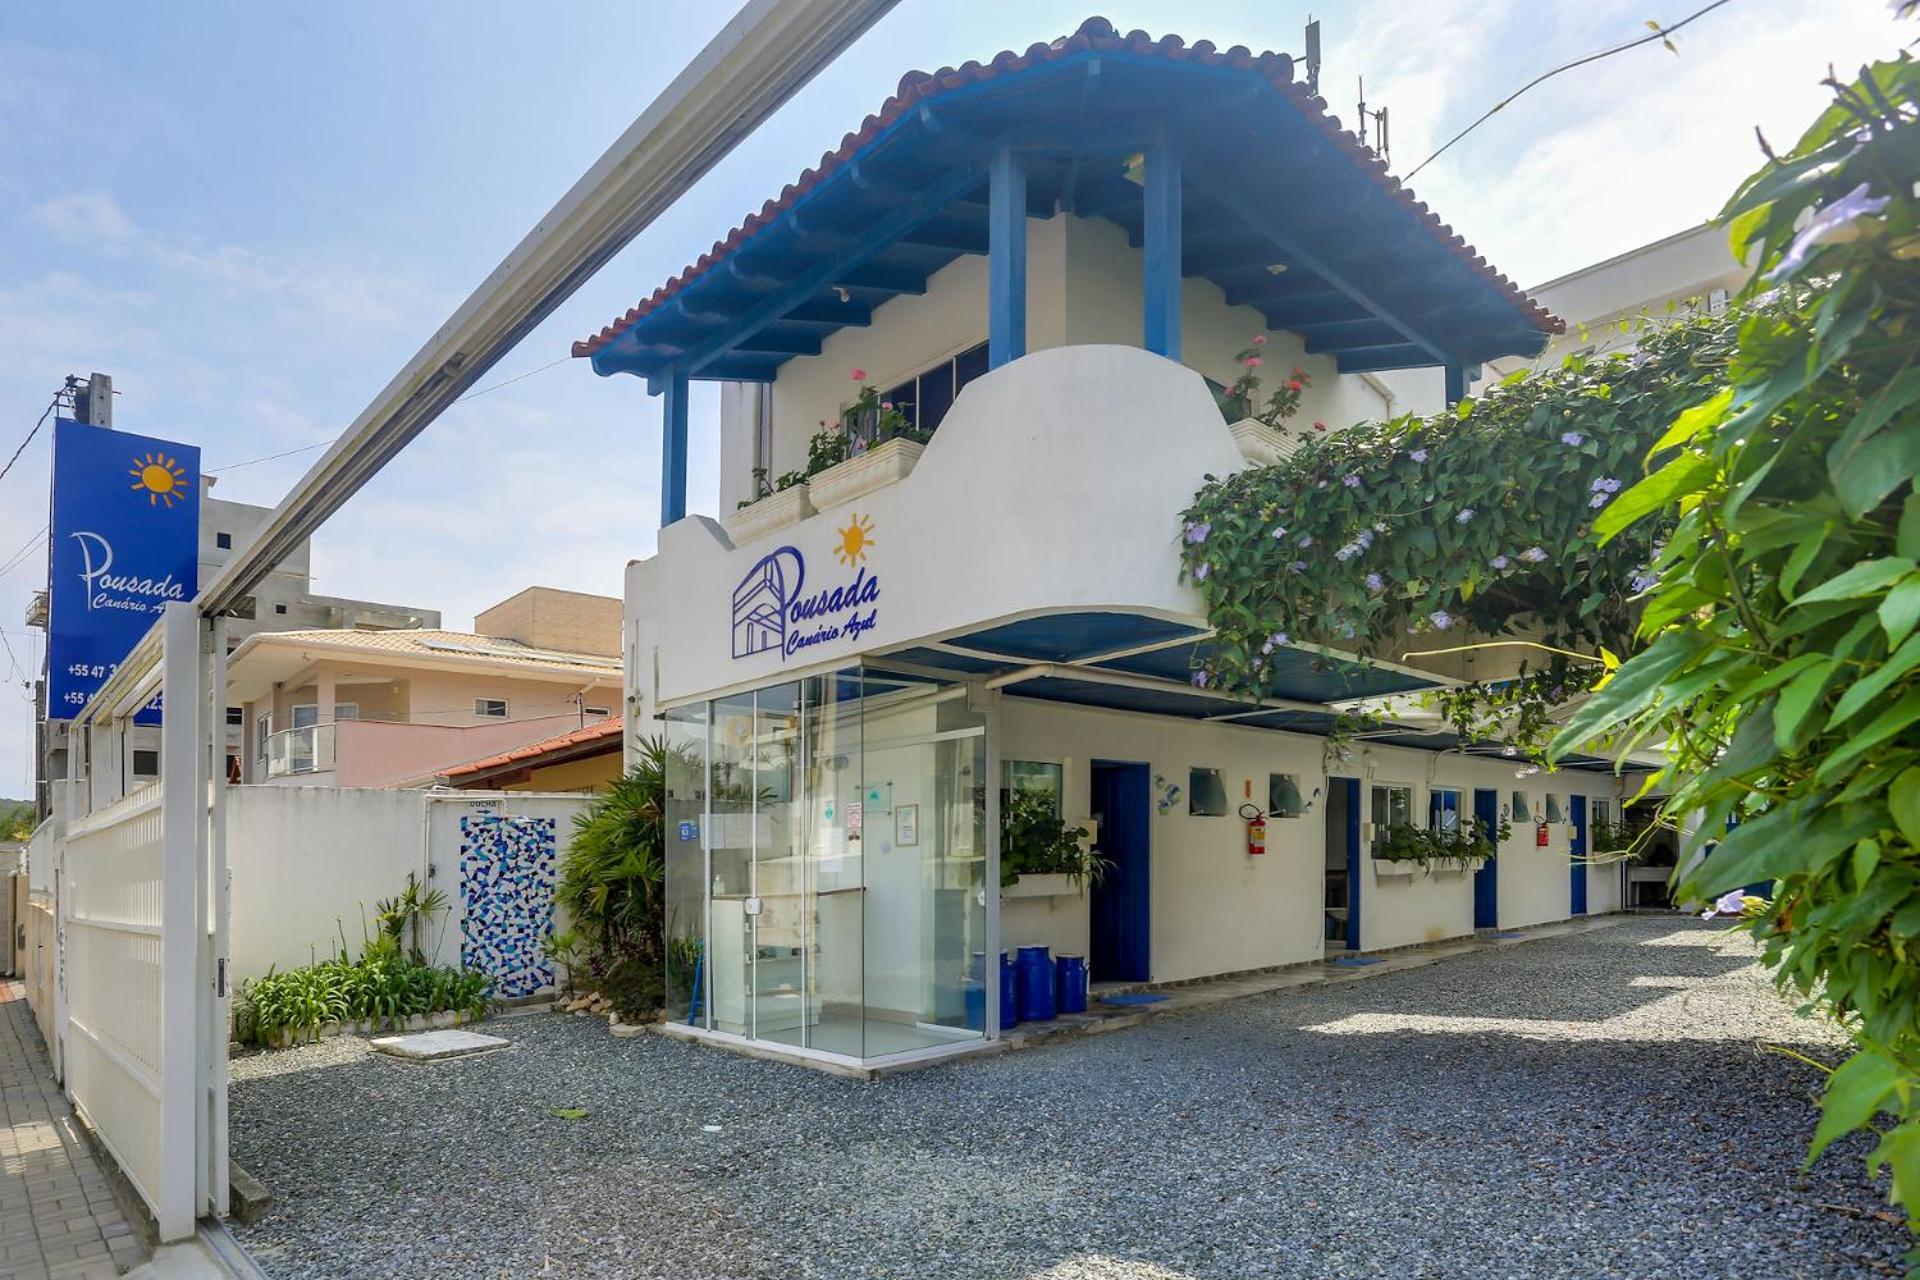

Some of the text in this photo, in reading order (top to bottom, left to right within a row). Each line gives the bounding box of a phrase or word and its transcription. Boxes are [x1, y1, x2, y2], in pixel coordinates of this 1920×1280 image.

[70, 531, 184, 612] Pousada
[93, 593, 147, 612] Canário
[772, 545, 880, 662] Pousada
[786, 608, 877, 655] Canário Azul
[69, 664, 88, 677] +55
[91, 665, 105, 678] 47
[64, 692, 84, 704] +55
